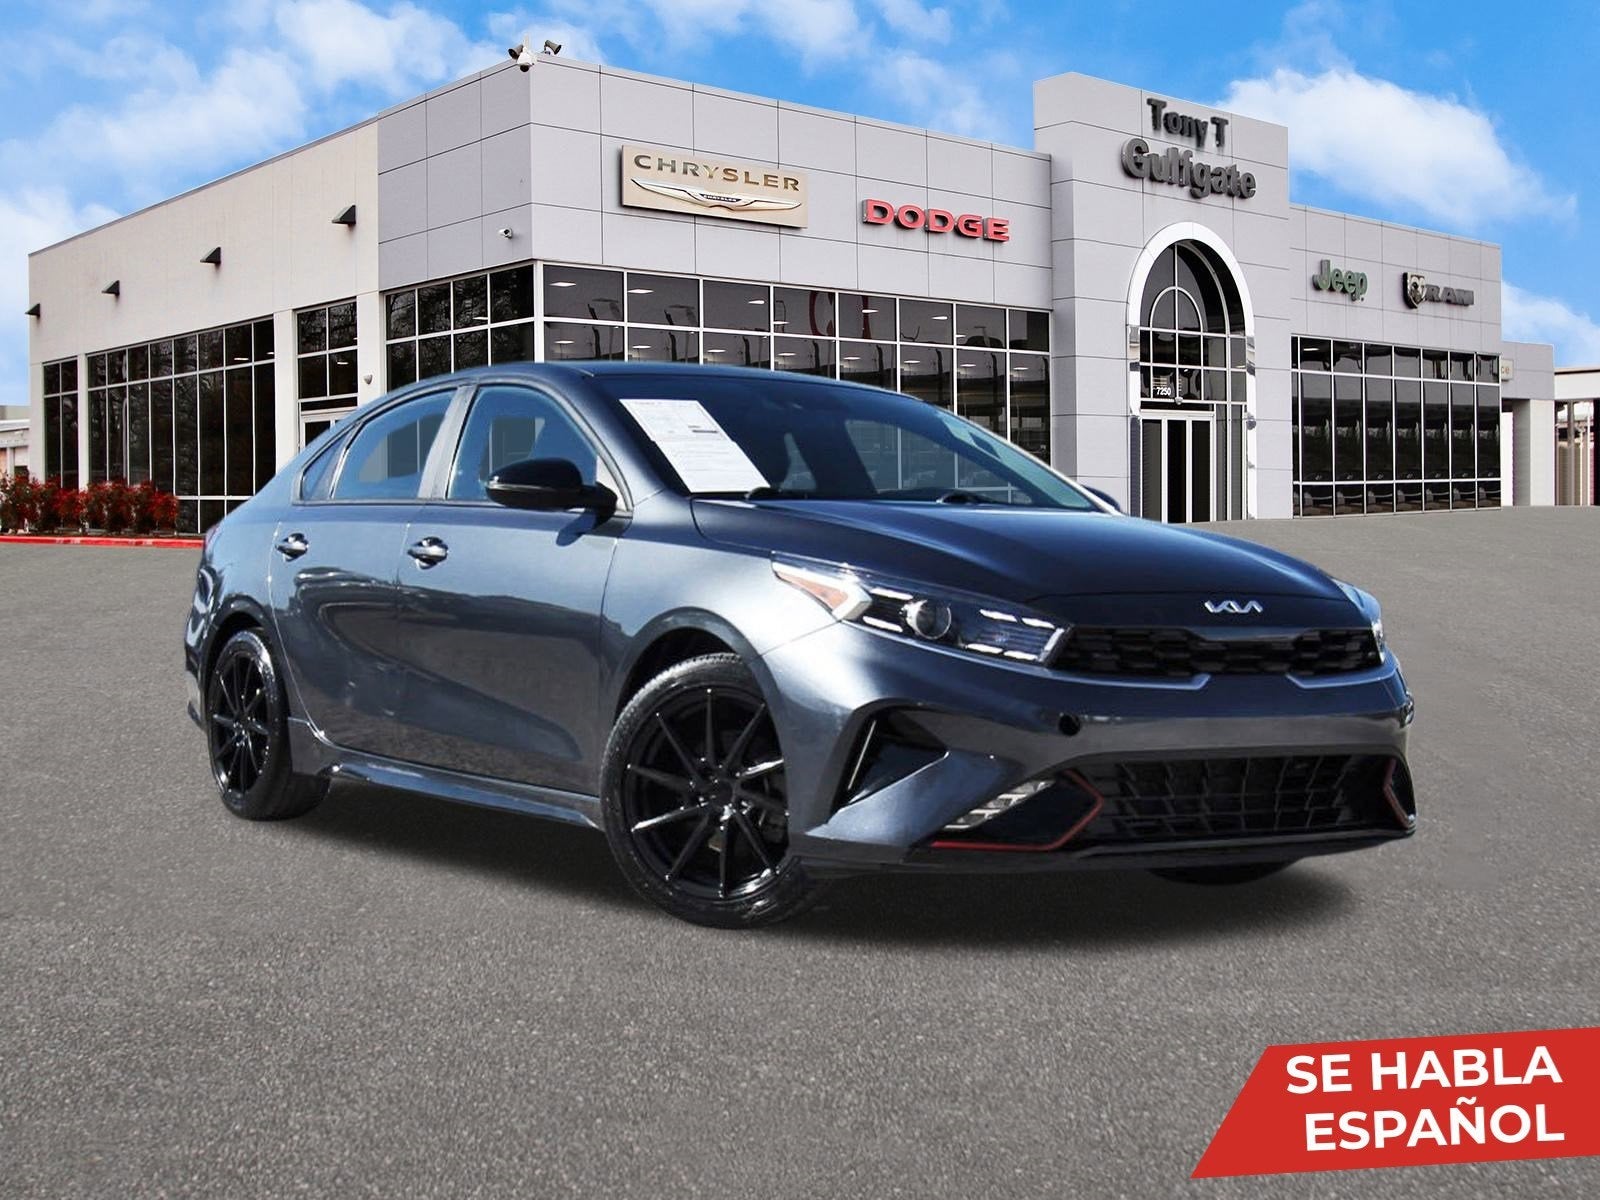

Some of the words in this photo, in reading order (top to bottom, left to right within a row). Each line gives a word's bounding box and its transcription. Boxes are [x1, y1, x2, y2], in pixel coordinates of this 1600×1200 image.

[1146, 98, 1208, 147] Tony
[1210, 116, 1229, 147] T
[633, 154, 800, 191] CHRYSLER
[1121, 138, 1257, 199] Gulfgate
[862, 198, 1010, 242] DODGE
[1312, 259, 1368, 302] Jeep
[1424, 284, 1475, 306] RAM
